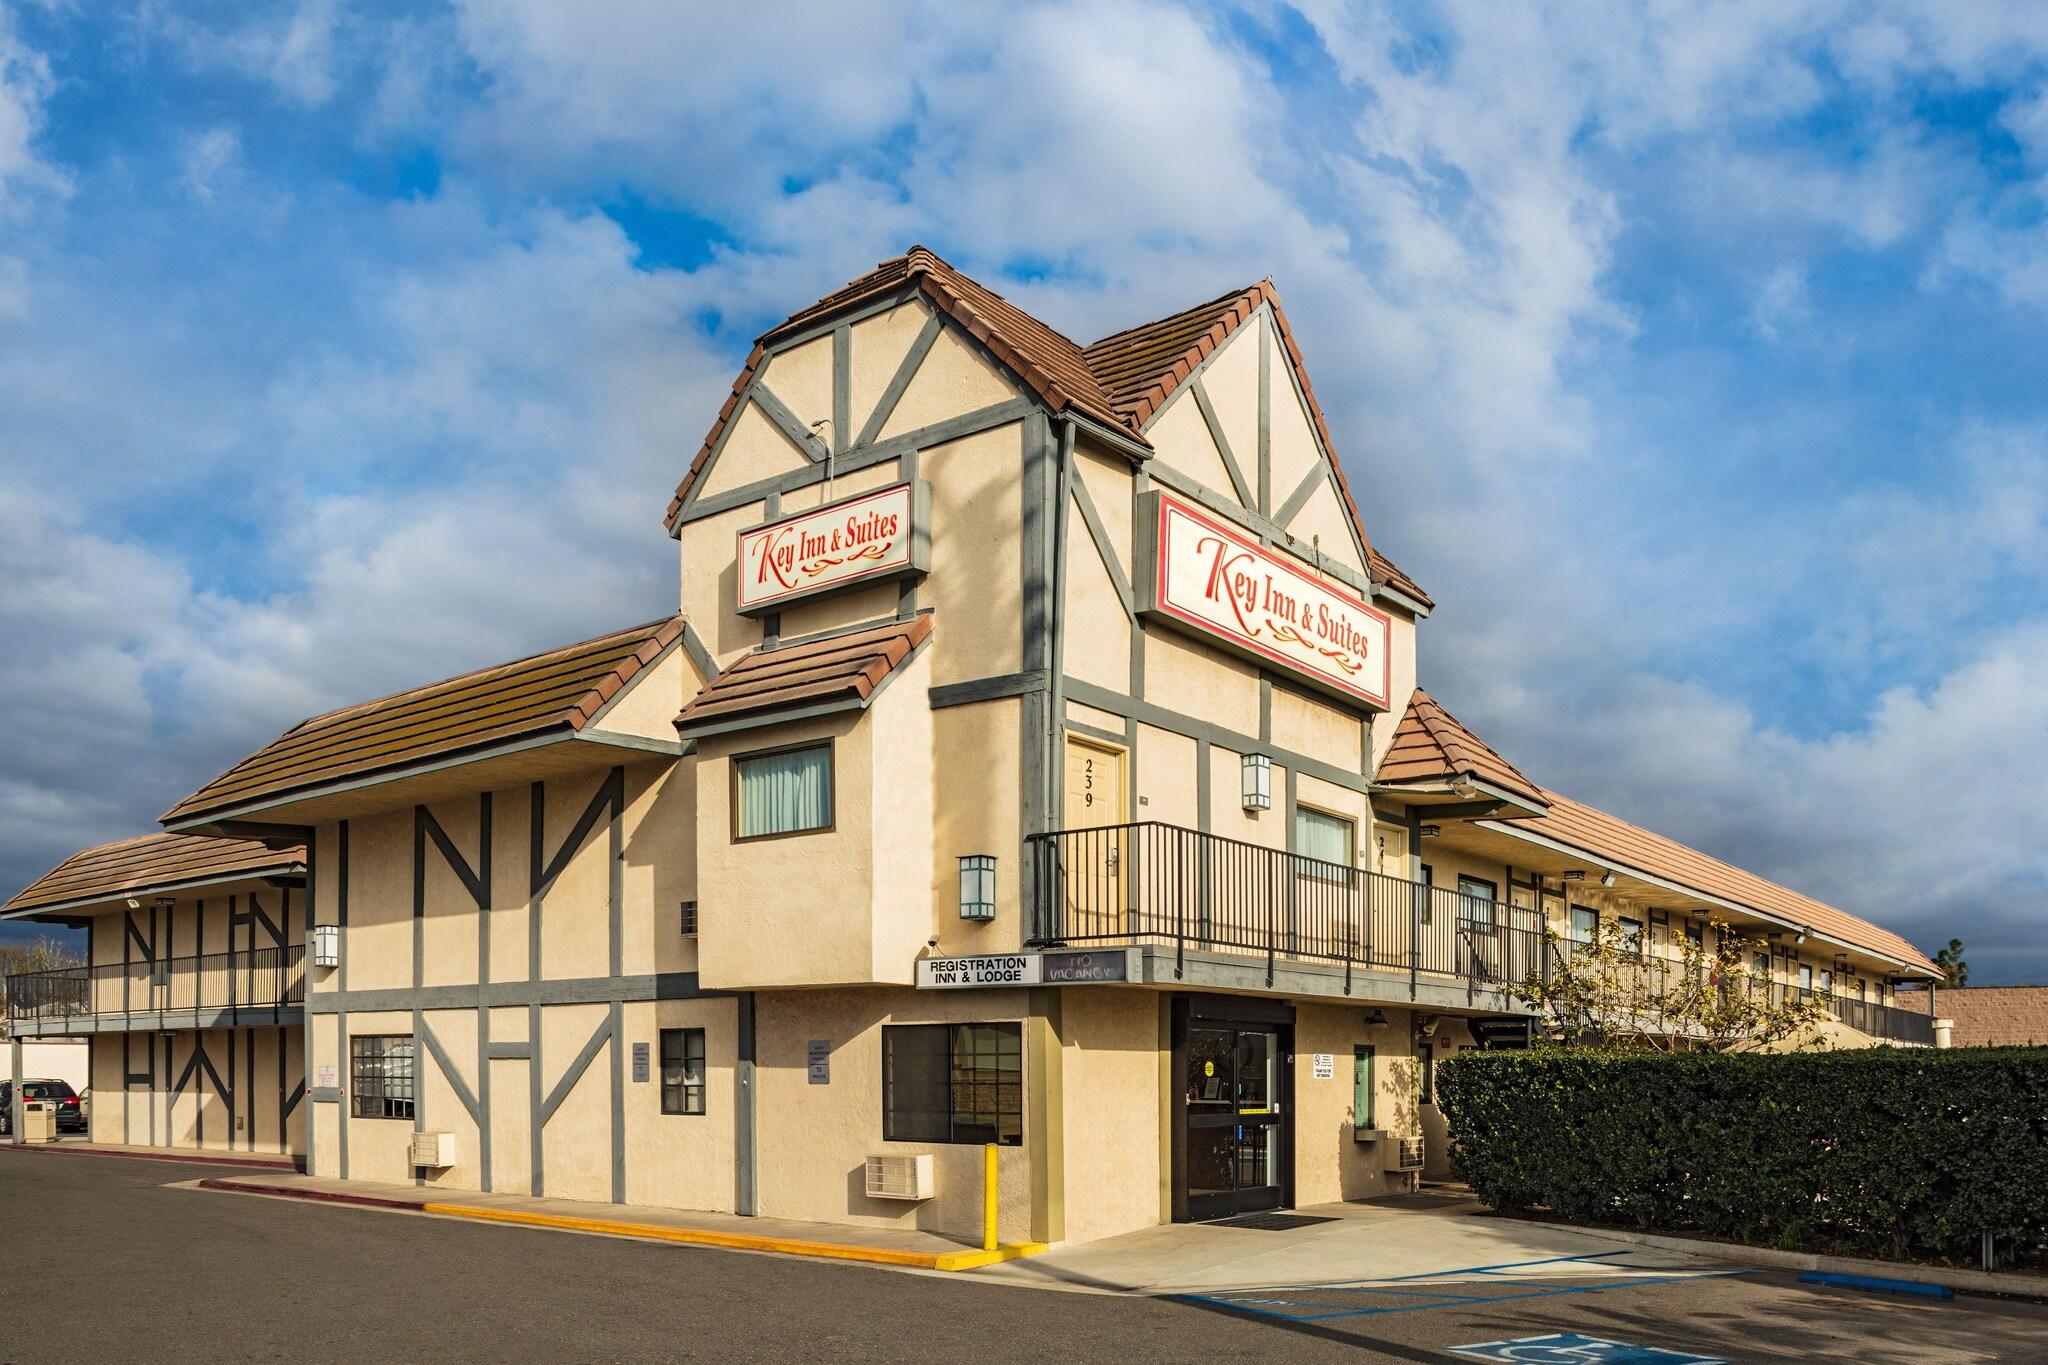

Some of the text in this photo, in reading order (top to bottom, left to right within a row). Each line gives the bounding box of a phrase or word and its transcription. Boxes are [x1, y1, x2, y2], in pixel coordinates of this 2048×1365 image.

[752, 511, 898, 588] Key Inn & Suites
[1196, 537, 1368, 659] Key Inn & Suites
[1085, 759, 1093, 807] 239
[930, 957, 1027, 972] REGISTRATION
[1071, 955, 1092, 967] NO
[935, 970, 1021, 983] INN & LODGE
[1049, 967, 1111, 980] VACANCY
